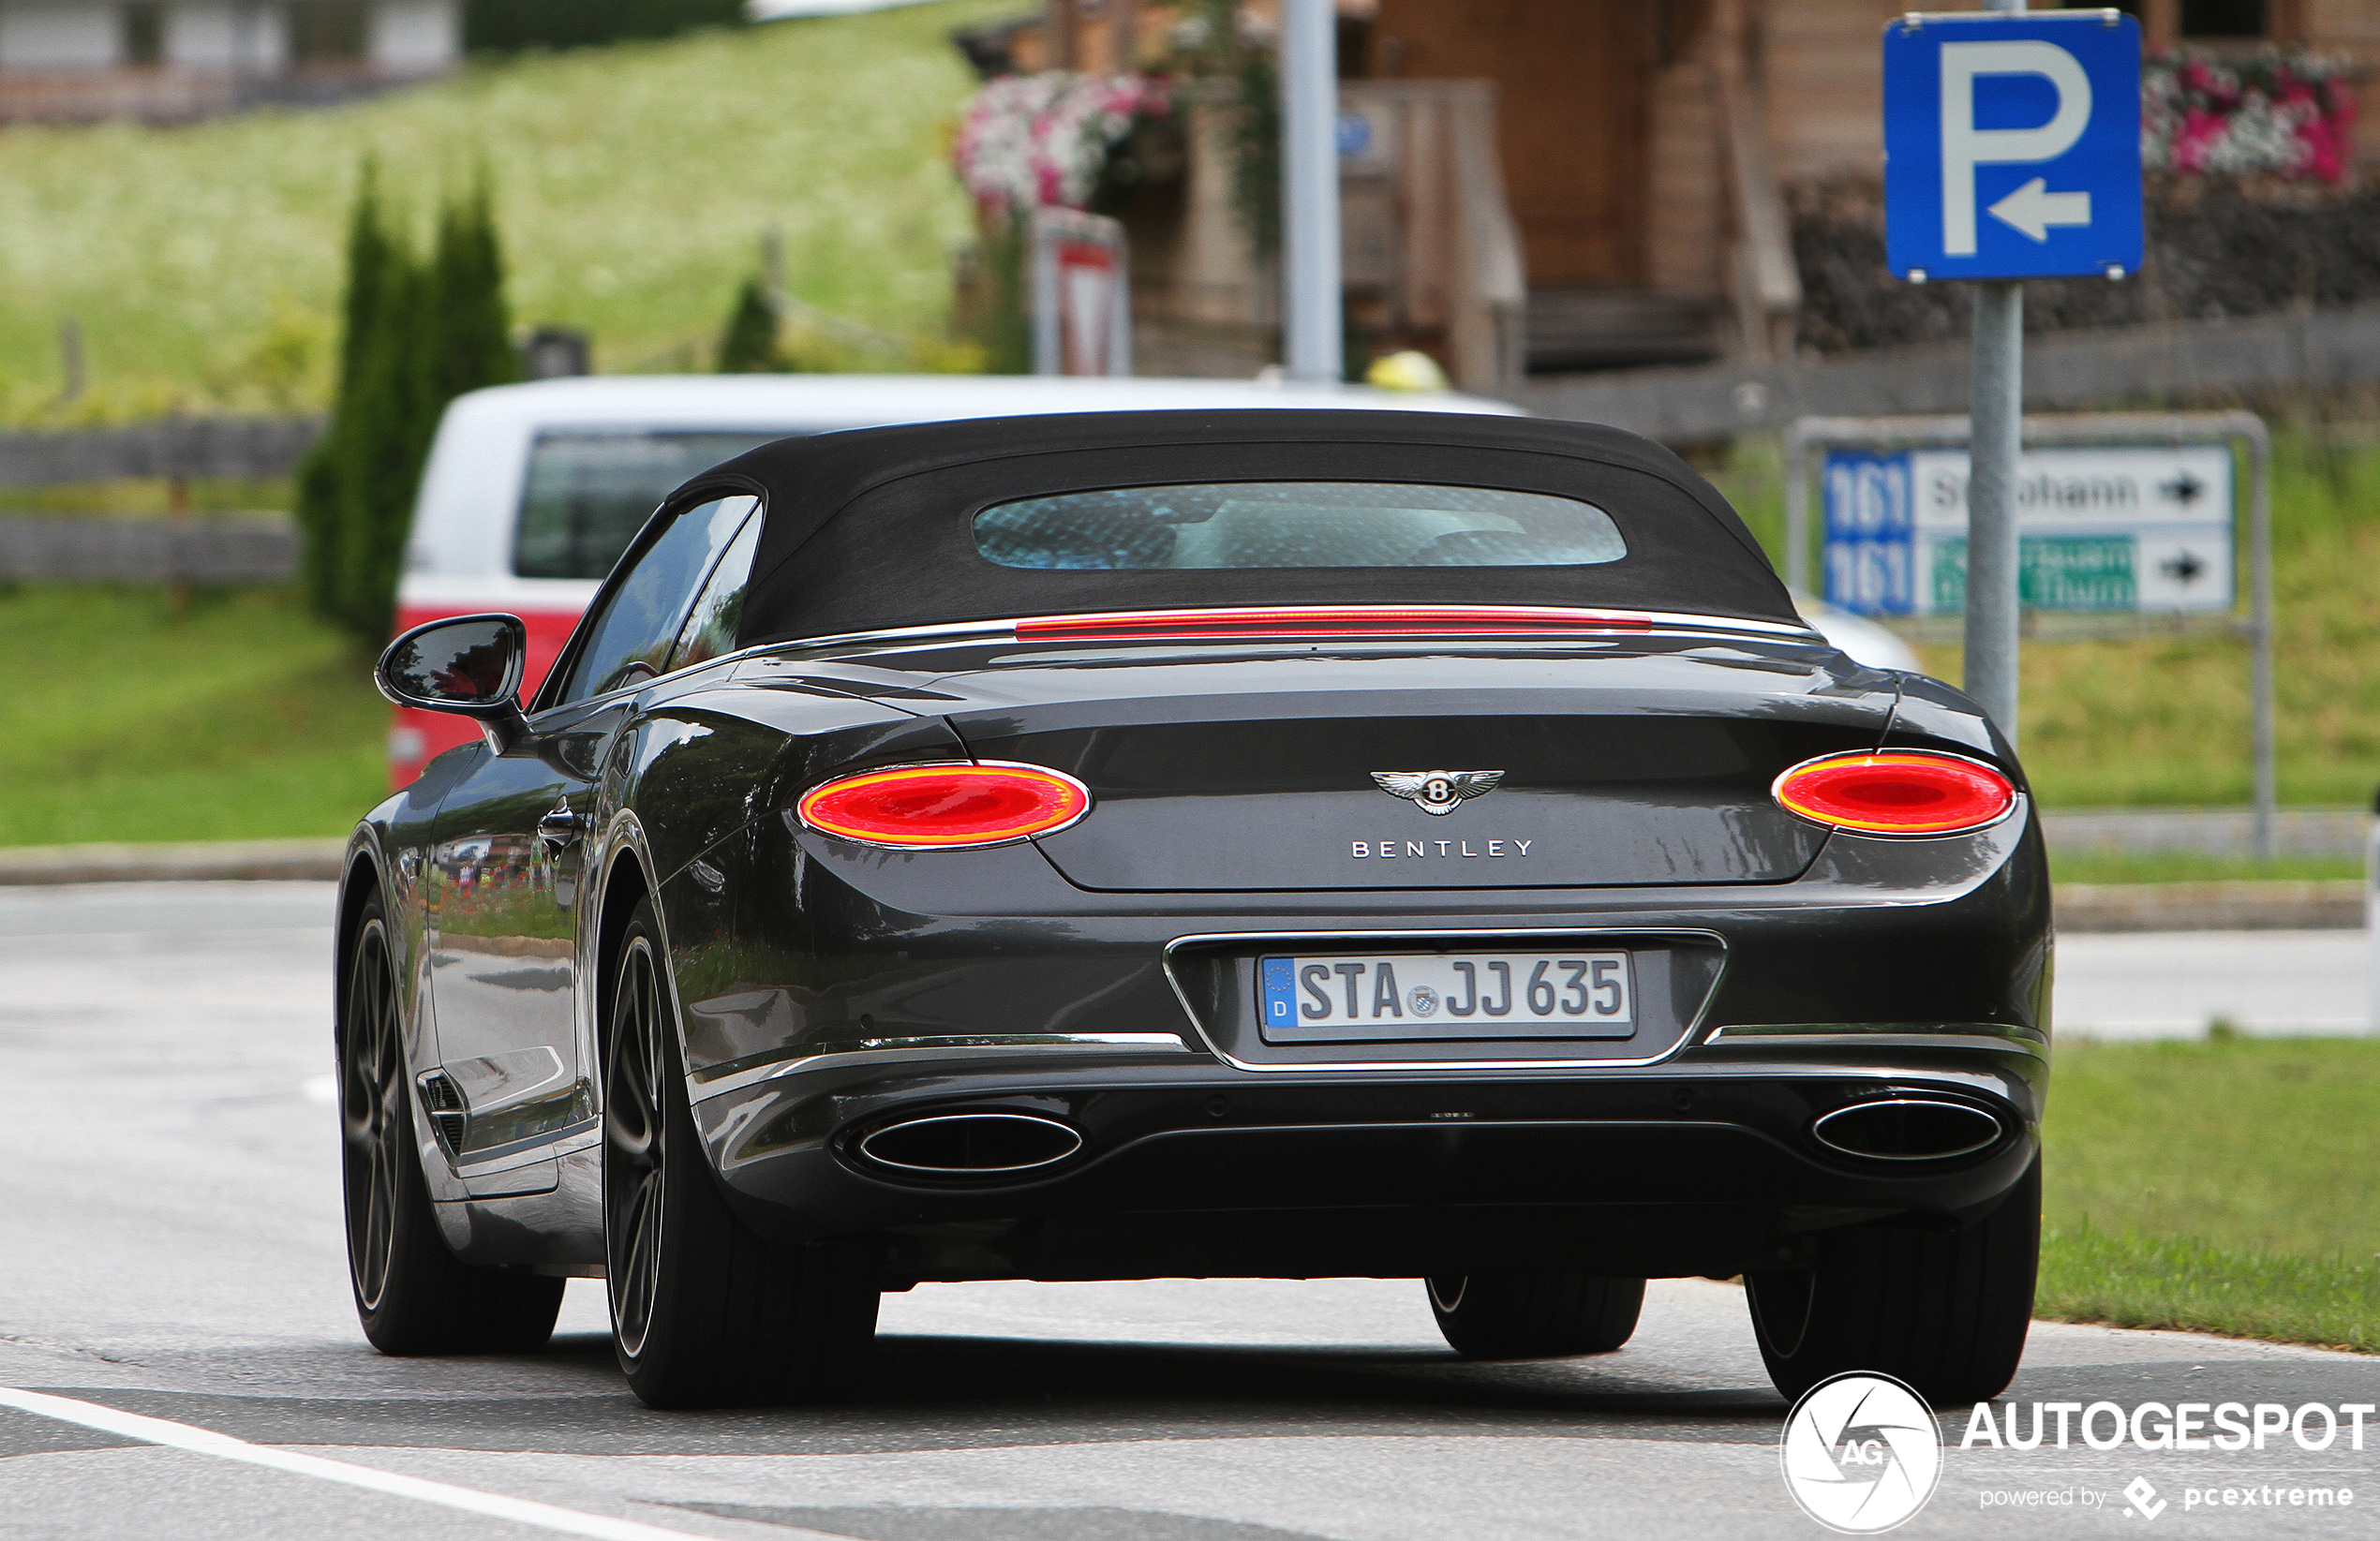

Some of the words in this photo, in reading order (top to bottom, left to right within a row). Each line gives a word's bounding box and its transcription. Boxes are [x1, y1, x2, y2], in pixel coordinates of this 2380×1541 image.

[1940, 39, 2092, 257] P
[1832, 463, 1906, 527] 161
[2016, 471, 2139, 509] ohann
[1832, 541, 1907, 604] 161
[1351, 839, 1533, 858] BENTLEY
[1273, 1000, 1287, 1017] D
[1300, 961, 1404, 1020] STA
[1446, 960, 1513, 1016] JJ
[1526, 959, 1623, 1016] 635
